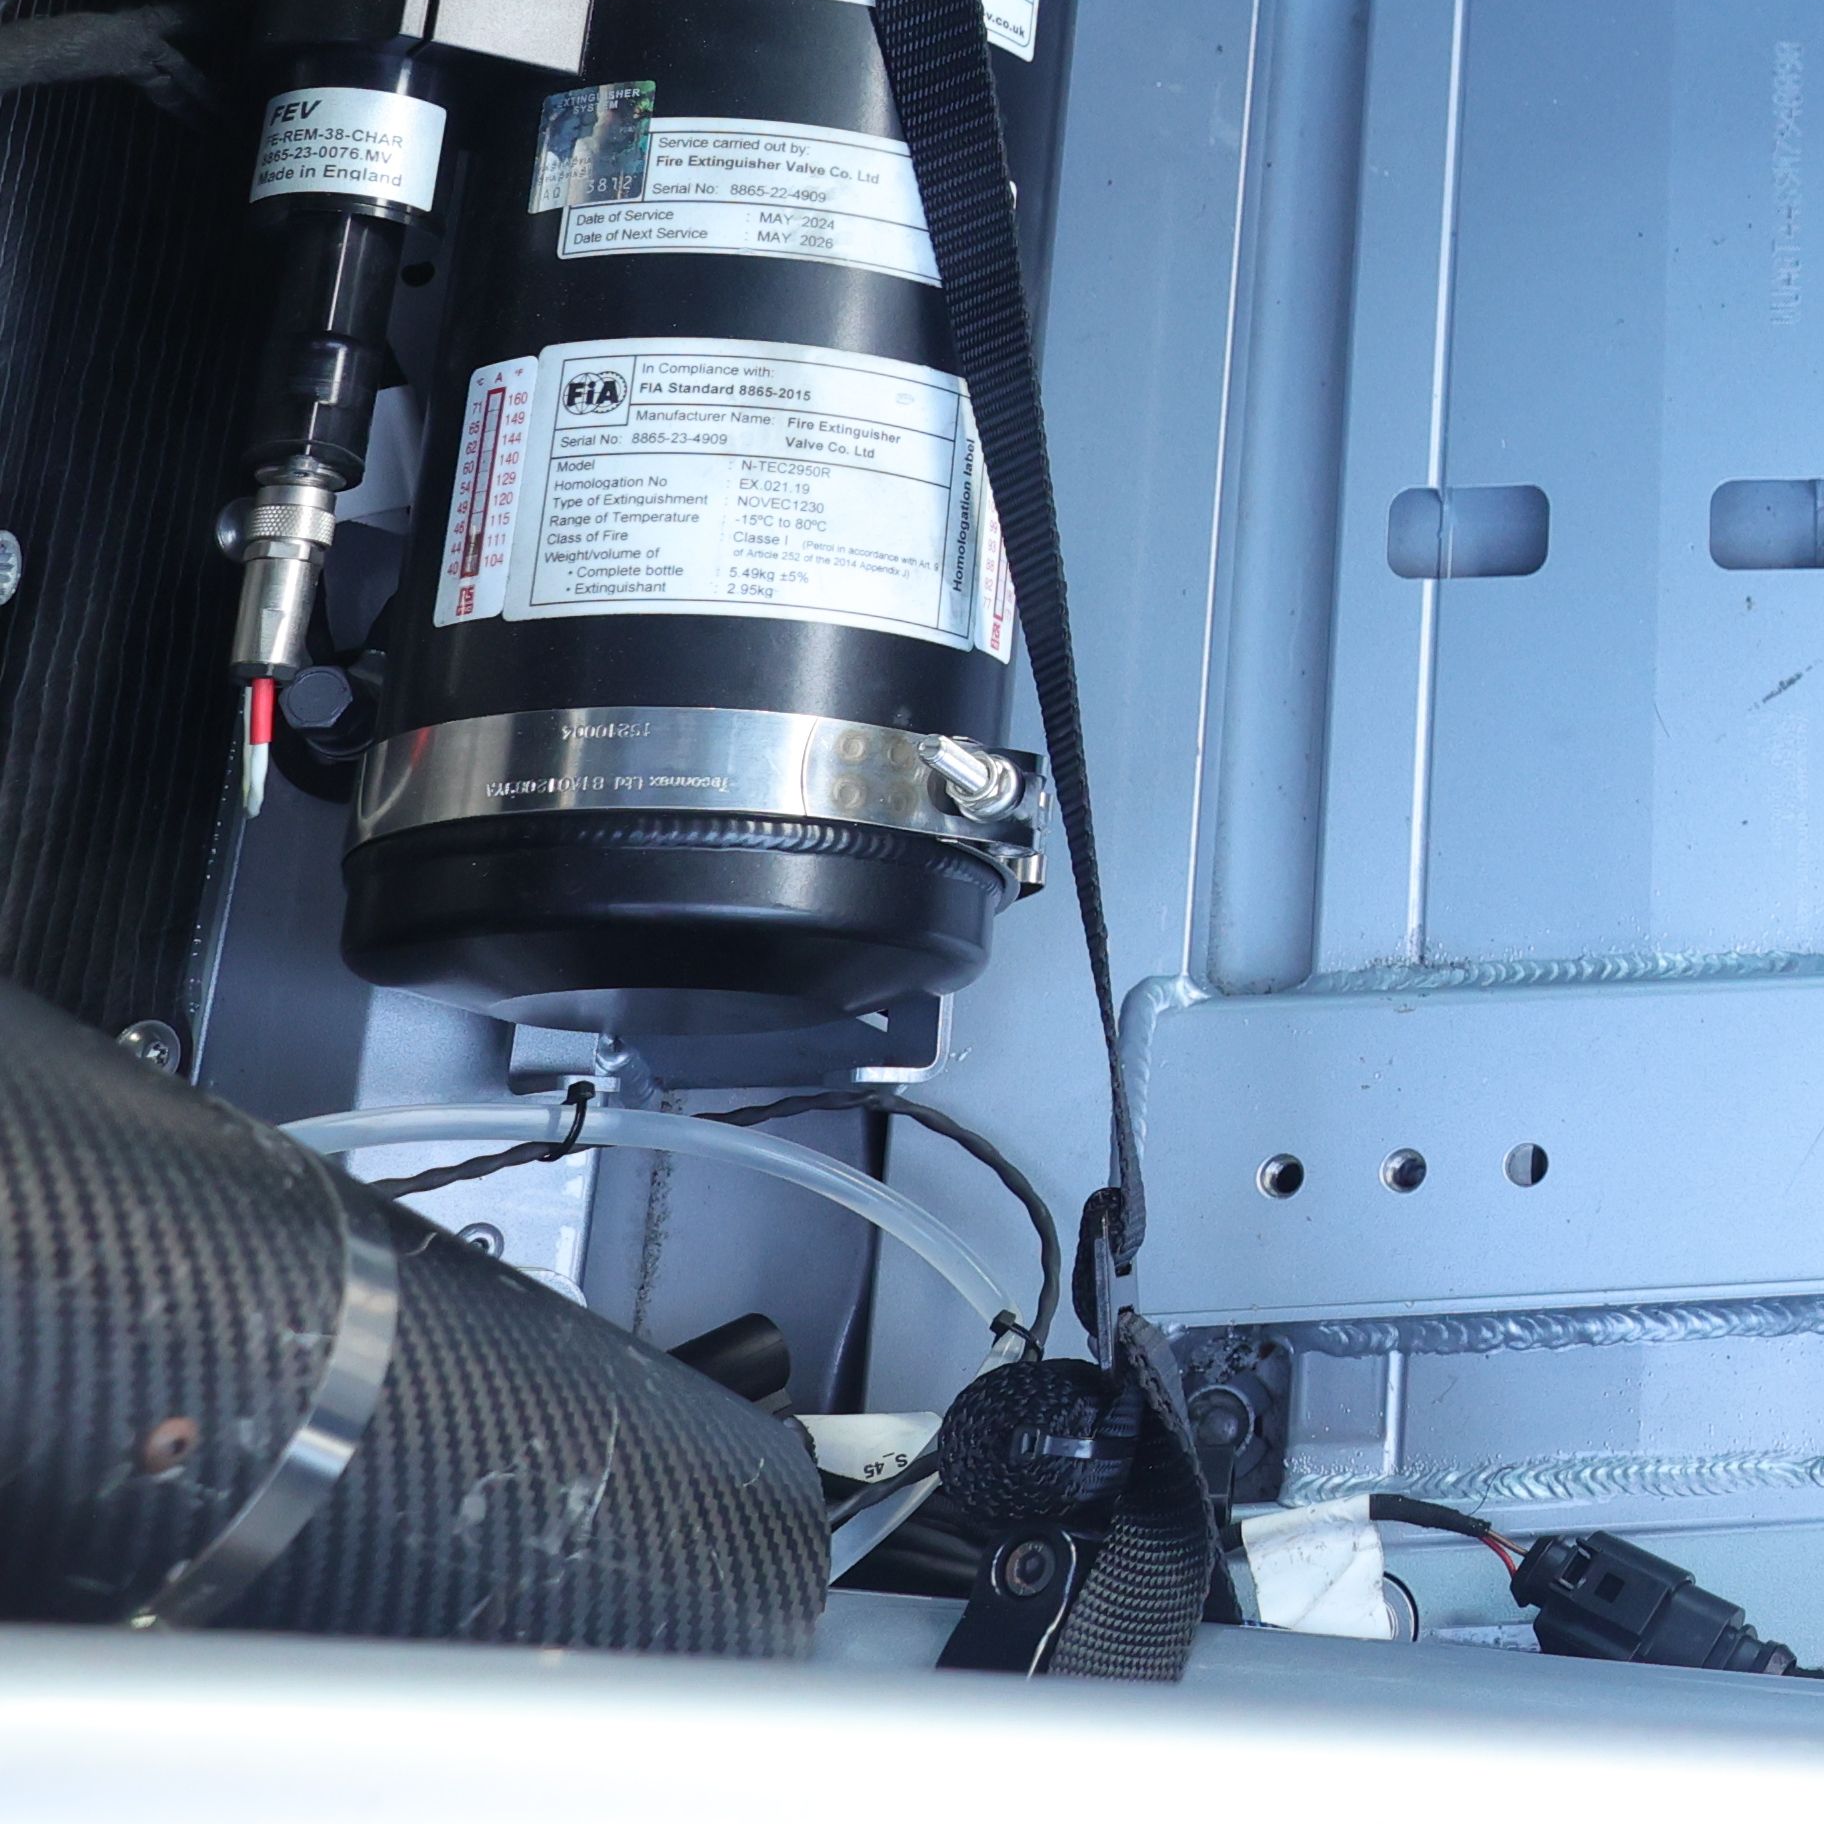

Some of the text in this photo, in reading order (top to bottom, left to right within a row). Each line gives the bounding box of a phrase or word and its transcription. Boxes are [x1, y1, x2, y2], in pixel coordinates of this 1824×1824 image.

[986, 10, 1027, 39] v.co.uk
[270, 100, 323, 126] FEV
[658, 135, 812, 158] Service carried out by:
[258, 164, 403, 187] Made in England
[656, 155, 880, 185] Fire Extinguisher Valve Co. Ltd
[652, 182, 828, 204] Serial No: 8865-22-4909
[576, 208, 836, 232] Date of Service MAY 2024
[573, 226, 834, 251] Date of Next Service MAY 2026
[642, 362, 776, 378] In Compliance with:
[508, 391, 528, 405] 160
[639, 382, 812, 401] FIA Standard 8865-2015
[505, 411, 525, 425] 149
[635, 410, 776, 426] Manufacturer Name:
[502, 431, 522, 445] 144
[787, 417, 902, 444] Fire Extinguisher
[560, 432, 729, 449] Serial No: 8865-23-4909
[785, 436, 876, 460] Valve Co. Ltd
[499, 451, 519, 465] 140
[556, 459, 832, 479] Model N-TEC2950R
[496, 472, 516, 486] 129
[554, 476, 811, 495] Homologation No EX.021.19
[493, 492, 513, 506] 120
[552, 494, 826, 514] Type of Extinguishment NOVEC1230
[490, 512, 510, 526] 115
[549, 512, 792, 528] Range of Temperature to
[952, 438, 976, 593] Homologation label
[487, 532, 506, 547] 111
[546, 533, 582, 546] Class
[586, 531, 600, 543] of
[602, 529, 629, 542] Fire
[733, 532, 781, 546] Classe
[484, 553, 504, 567] 104
[544, 546, 661, 564] Weight/volume of
[576, 564, 642, 578] Complete
[645, 564, 684, 576] bottle
[729, 567, 775, 581] 5.49kg
[574, 582, 774, 598] Extinguishant 2.95kg
[863, 1451, 908, 1480] S_45
